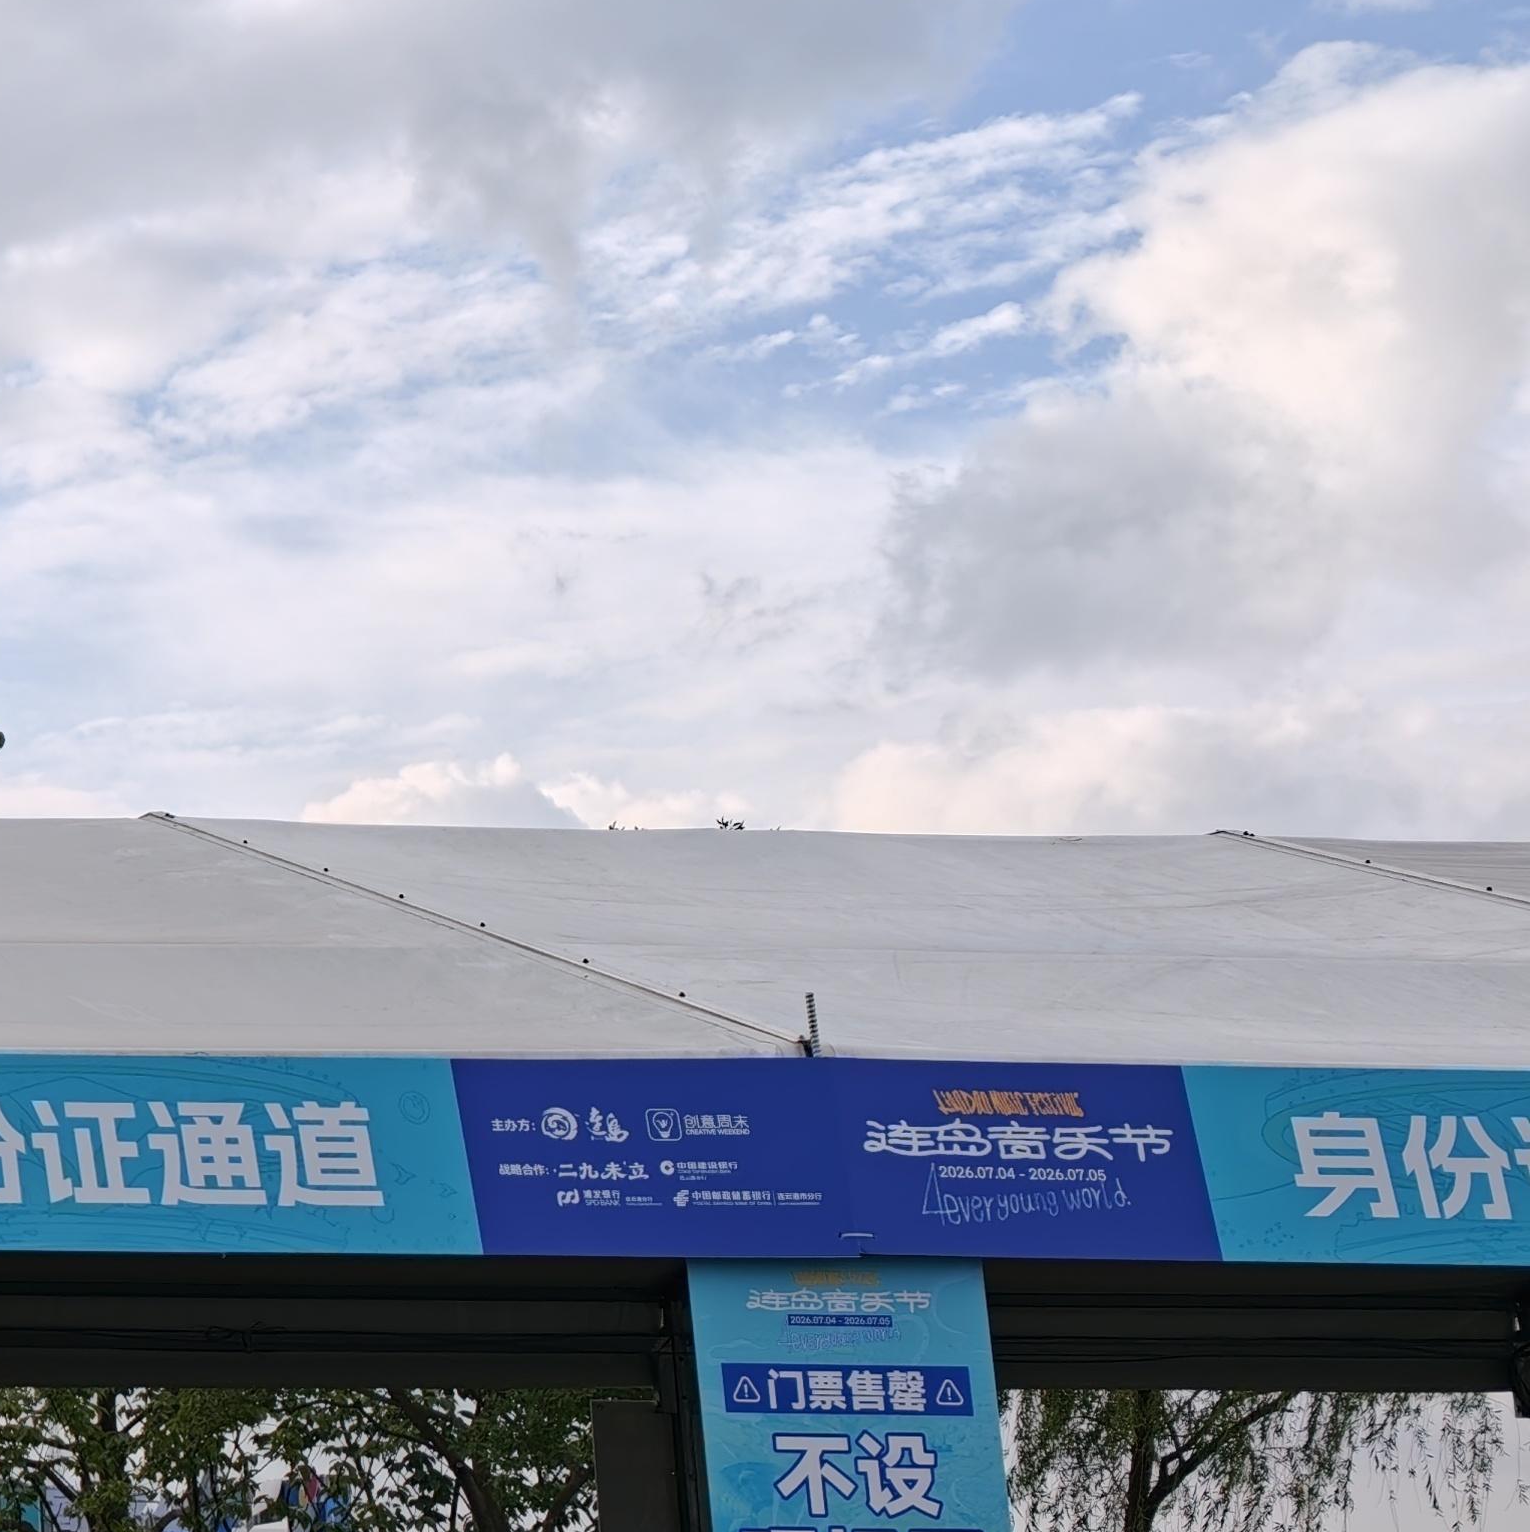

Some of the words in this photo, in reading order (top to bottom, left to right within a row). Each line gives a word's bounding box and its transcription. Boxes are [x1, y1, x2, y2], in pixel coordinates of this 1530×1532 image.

[683, 1115, 750, 1128] 创意周末
[864, 1118, 1173, 1162] 连岛音乐节
[939, 1166, 1015, 1179] 2026.07.04
[1029, 1168, 1106, 1181] 2026.07.05
[1291, 1112, 1530, 1221] 身份
[746, 1288, 931, 1313] 连岛音乐节
[767, 1368, 927, 1412] 门票售罄
[775, 1431, 942, 1518] 不设
